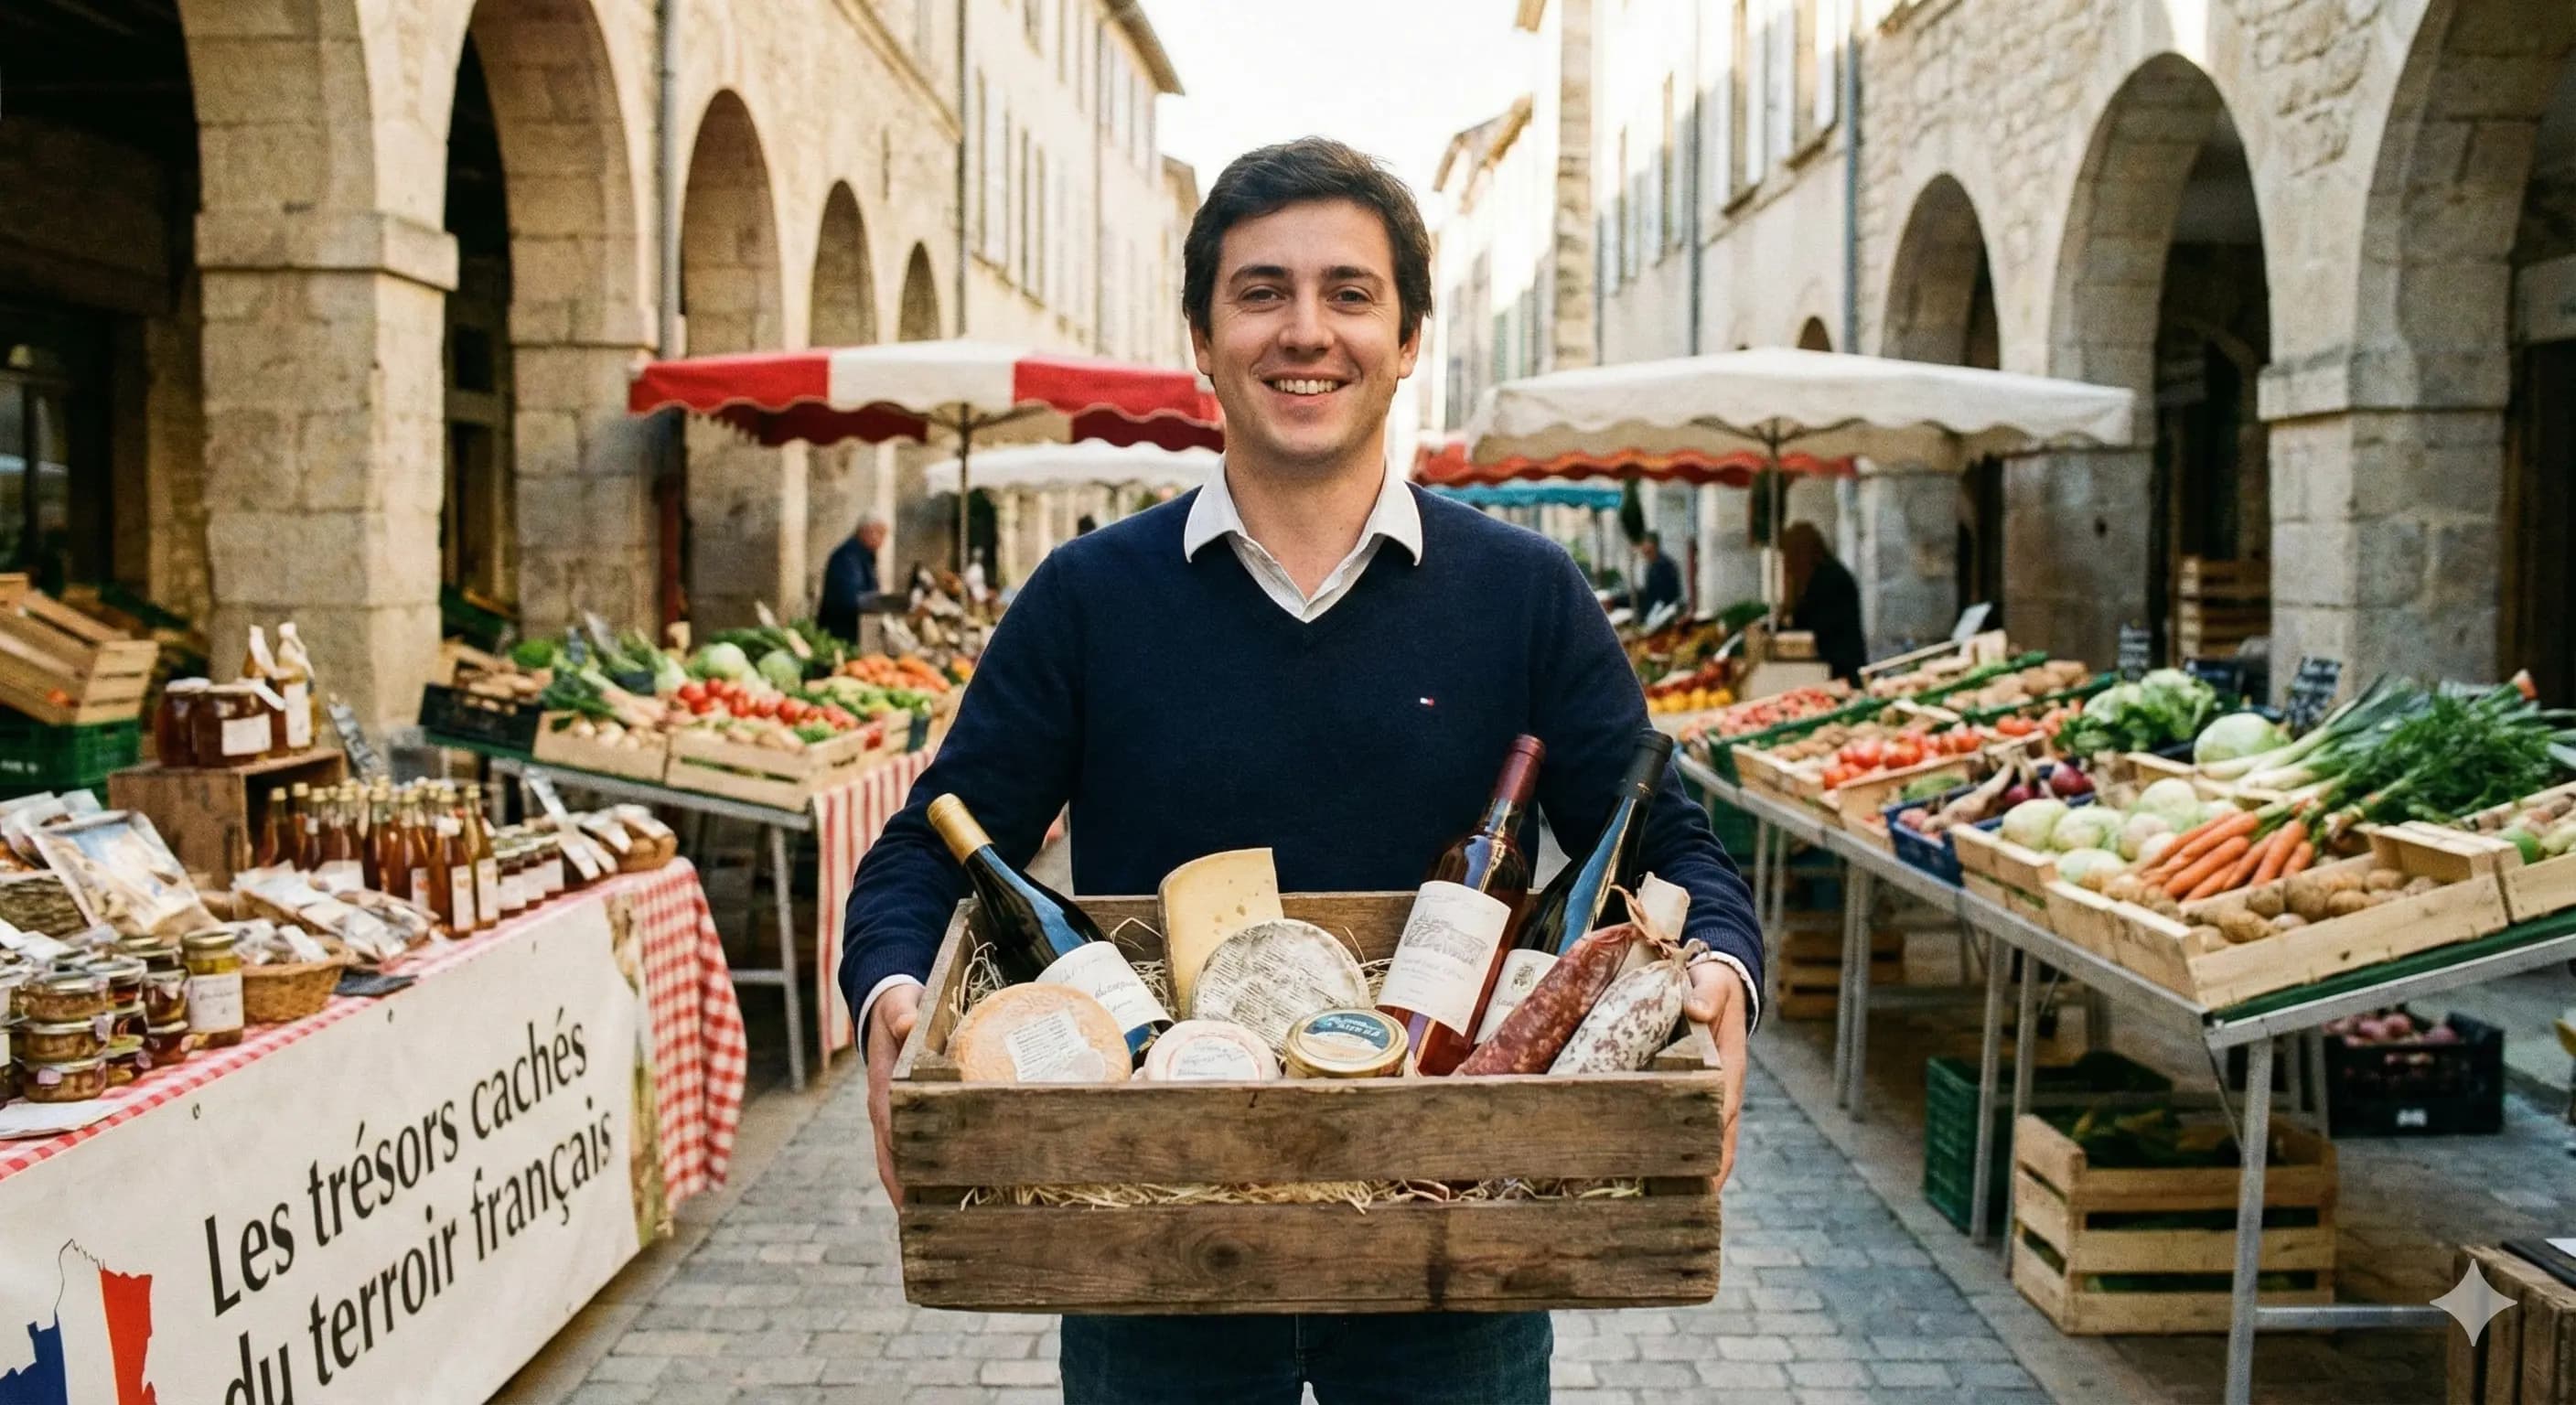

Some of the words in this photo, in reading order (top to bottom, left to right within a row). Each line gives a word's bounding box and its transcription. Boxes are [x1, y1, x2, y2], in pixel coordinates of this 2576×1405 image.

[205, 1202, 295, 1317] Les
[307, 1100, 459, 1247] trésors
[470, 1006, 588, 1141] cachés
[225, 1330, 294, 1405] du
[308, 1205, 457, 1387] terroir
[470, 1097, 612, 1261] français
